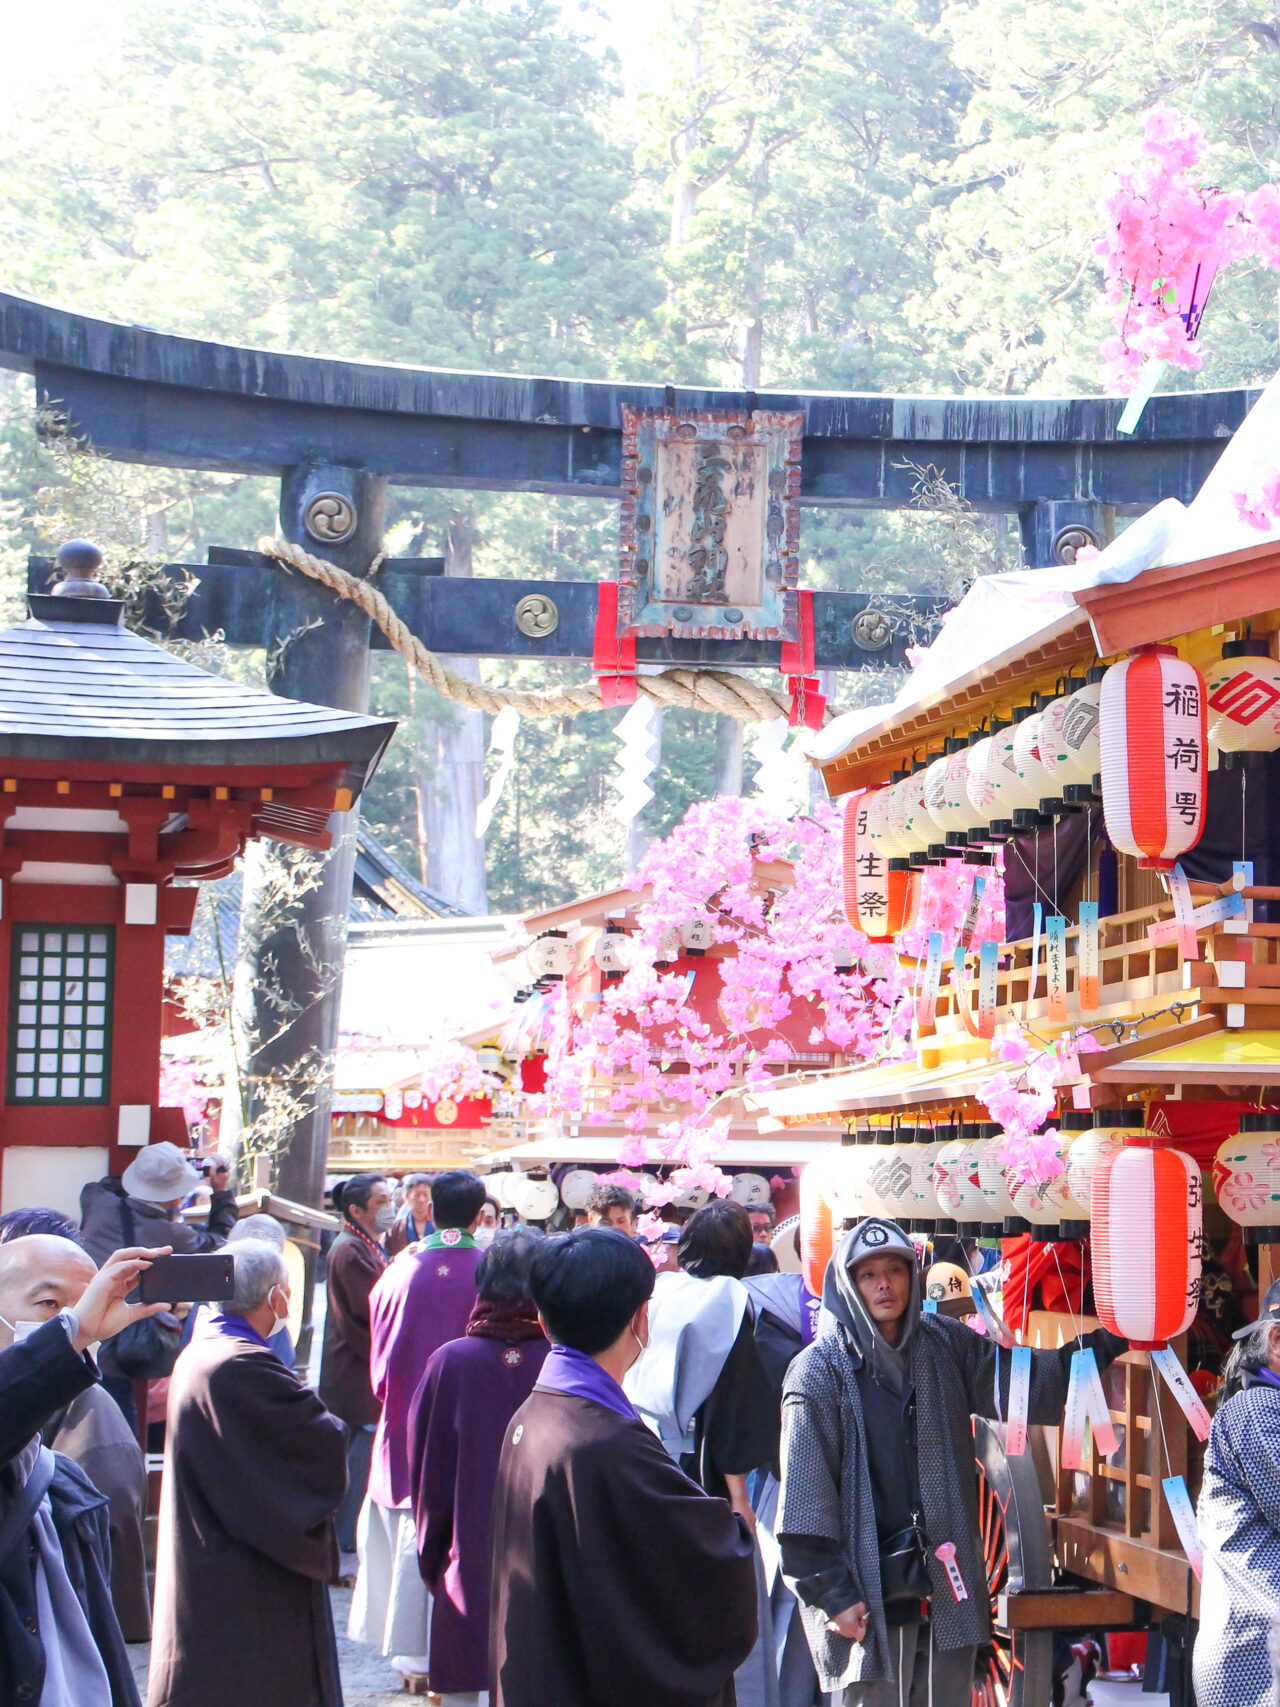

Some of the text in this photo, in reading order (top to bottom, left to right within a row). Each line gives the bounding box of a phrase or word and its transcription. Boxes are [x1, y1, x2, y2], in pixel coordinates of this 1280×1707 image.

[1049, 930, 1062, 1004] 晴れますように
[947, 1276, 962, 1293] 侍
